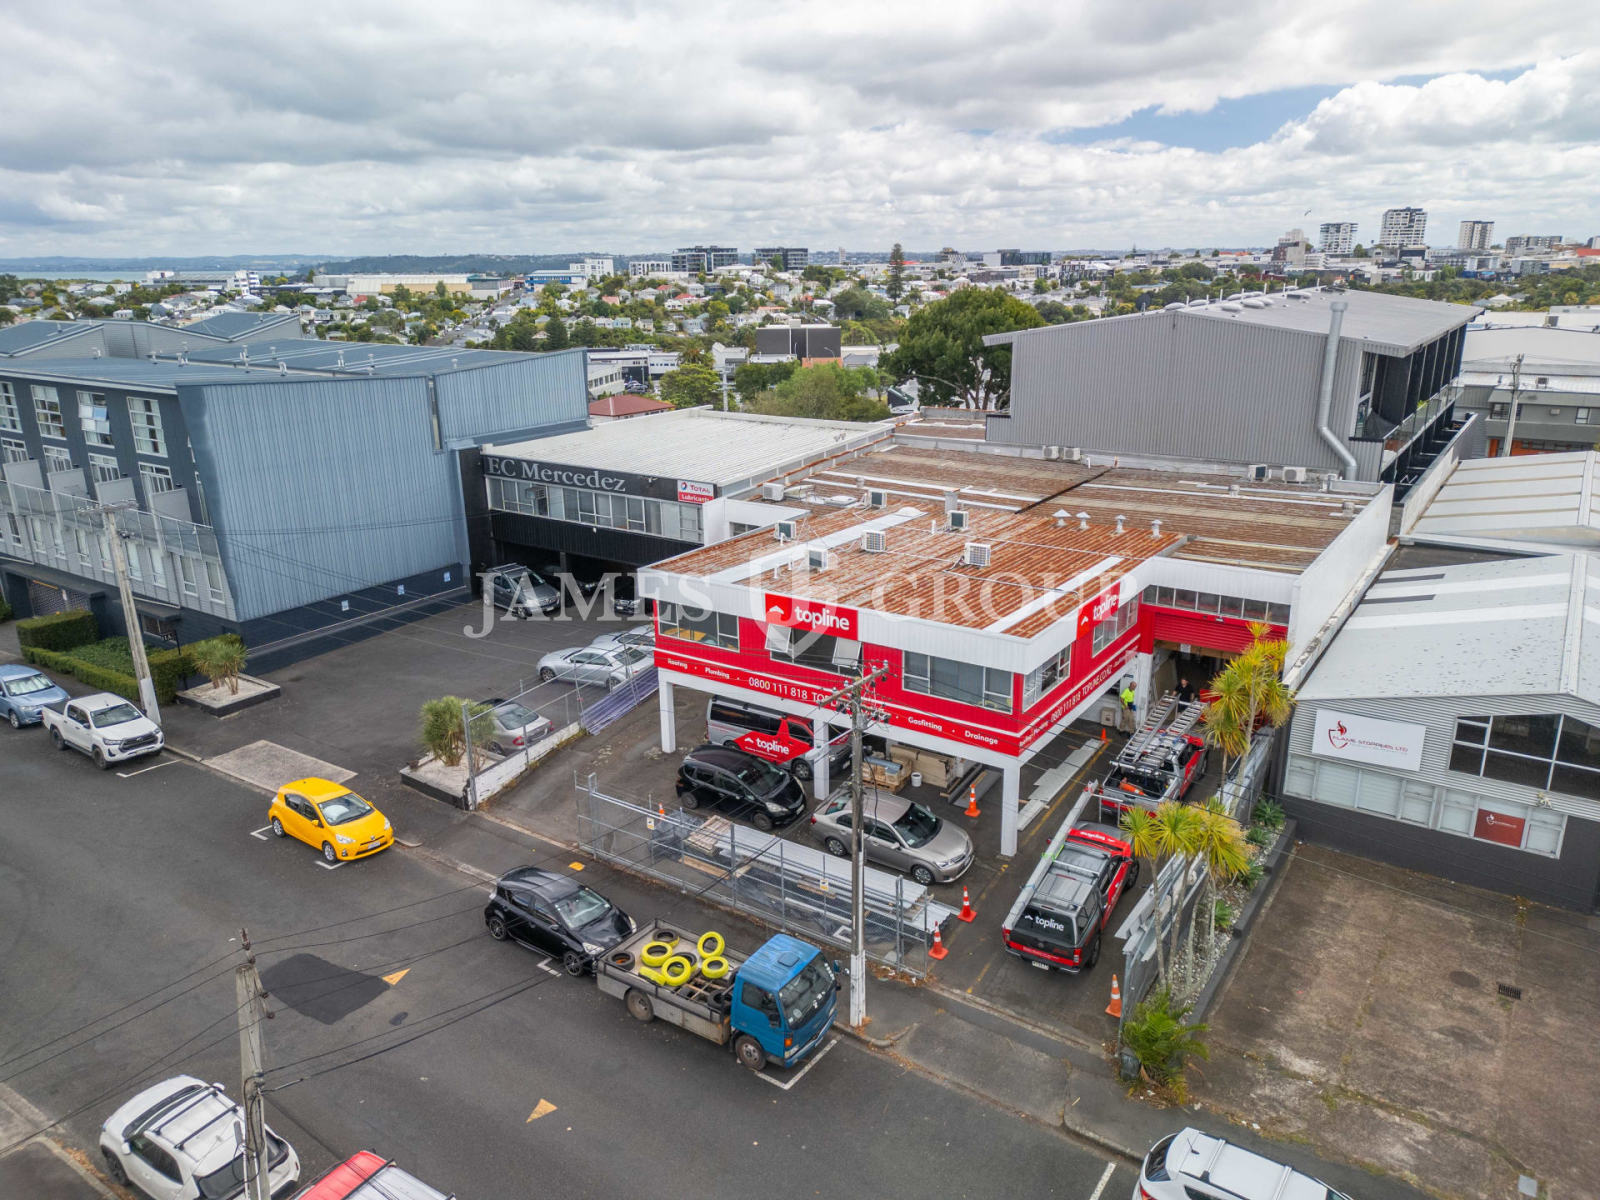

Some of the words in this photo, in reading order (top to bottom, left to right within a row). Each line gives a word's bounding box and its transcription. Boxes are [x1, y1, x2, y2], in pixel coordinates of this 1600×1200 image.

[487, 457, 516, 477] EC
[521, 461, 626, 492] Mercedez
[794, 605, 850, 631] topline
[667, 658, 688, 670] Roofing
[704, 667, 730, 679] Plumbing
[749, 676, 771, 691] 0800
[772, 682, 788, 696] 111
[790, 687, 808, 700] 818
[907, 716, 943, 732] Gasfitting
[964, 730, 999, 745] Drainage
[756, 737, 790, 755] topline
[1035, 915, 1065, 931] topline
